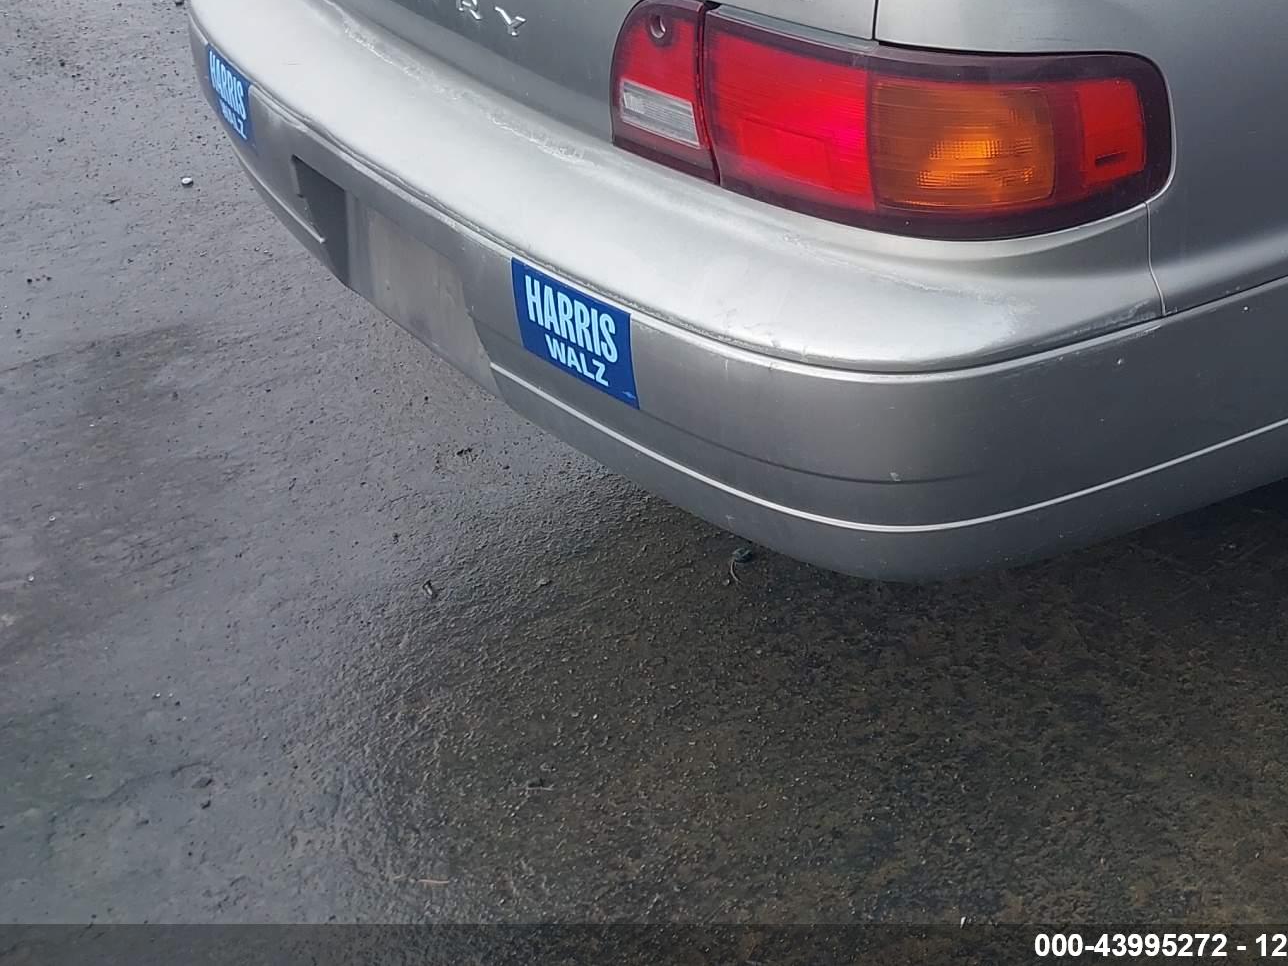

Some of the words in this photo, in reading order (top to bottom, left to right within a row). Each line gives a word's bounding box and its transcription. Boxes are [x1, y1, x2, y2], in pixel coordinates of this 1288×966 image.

[209, 50, 247, 121] HARRIS
[525, 274, 619, 363] HARRIS
[545, 334, 609, 387] WALZ
